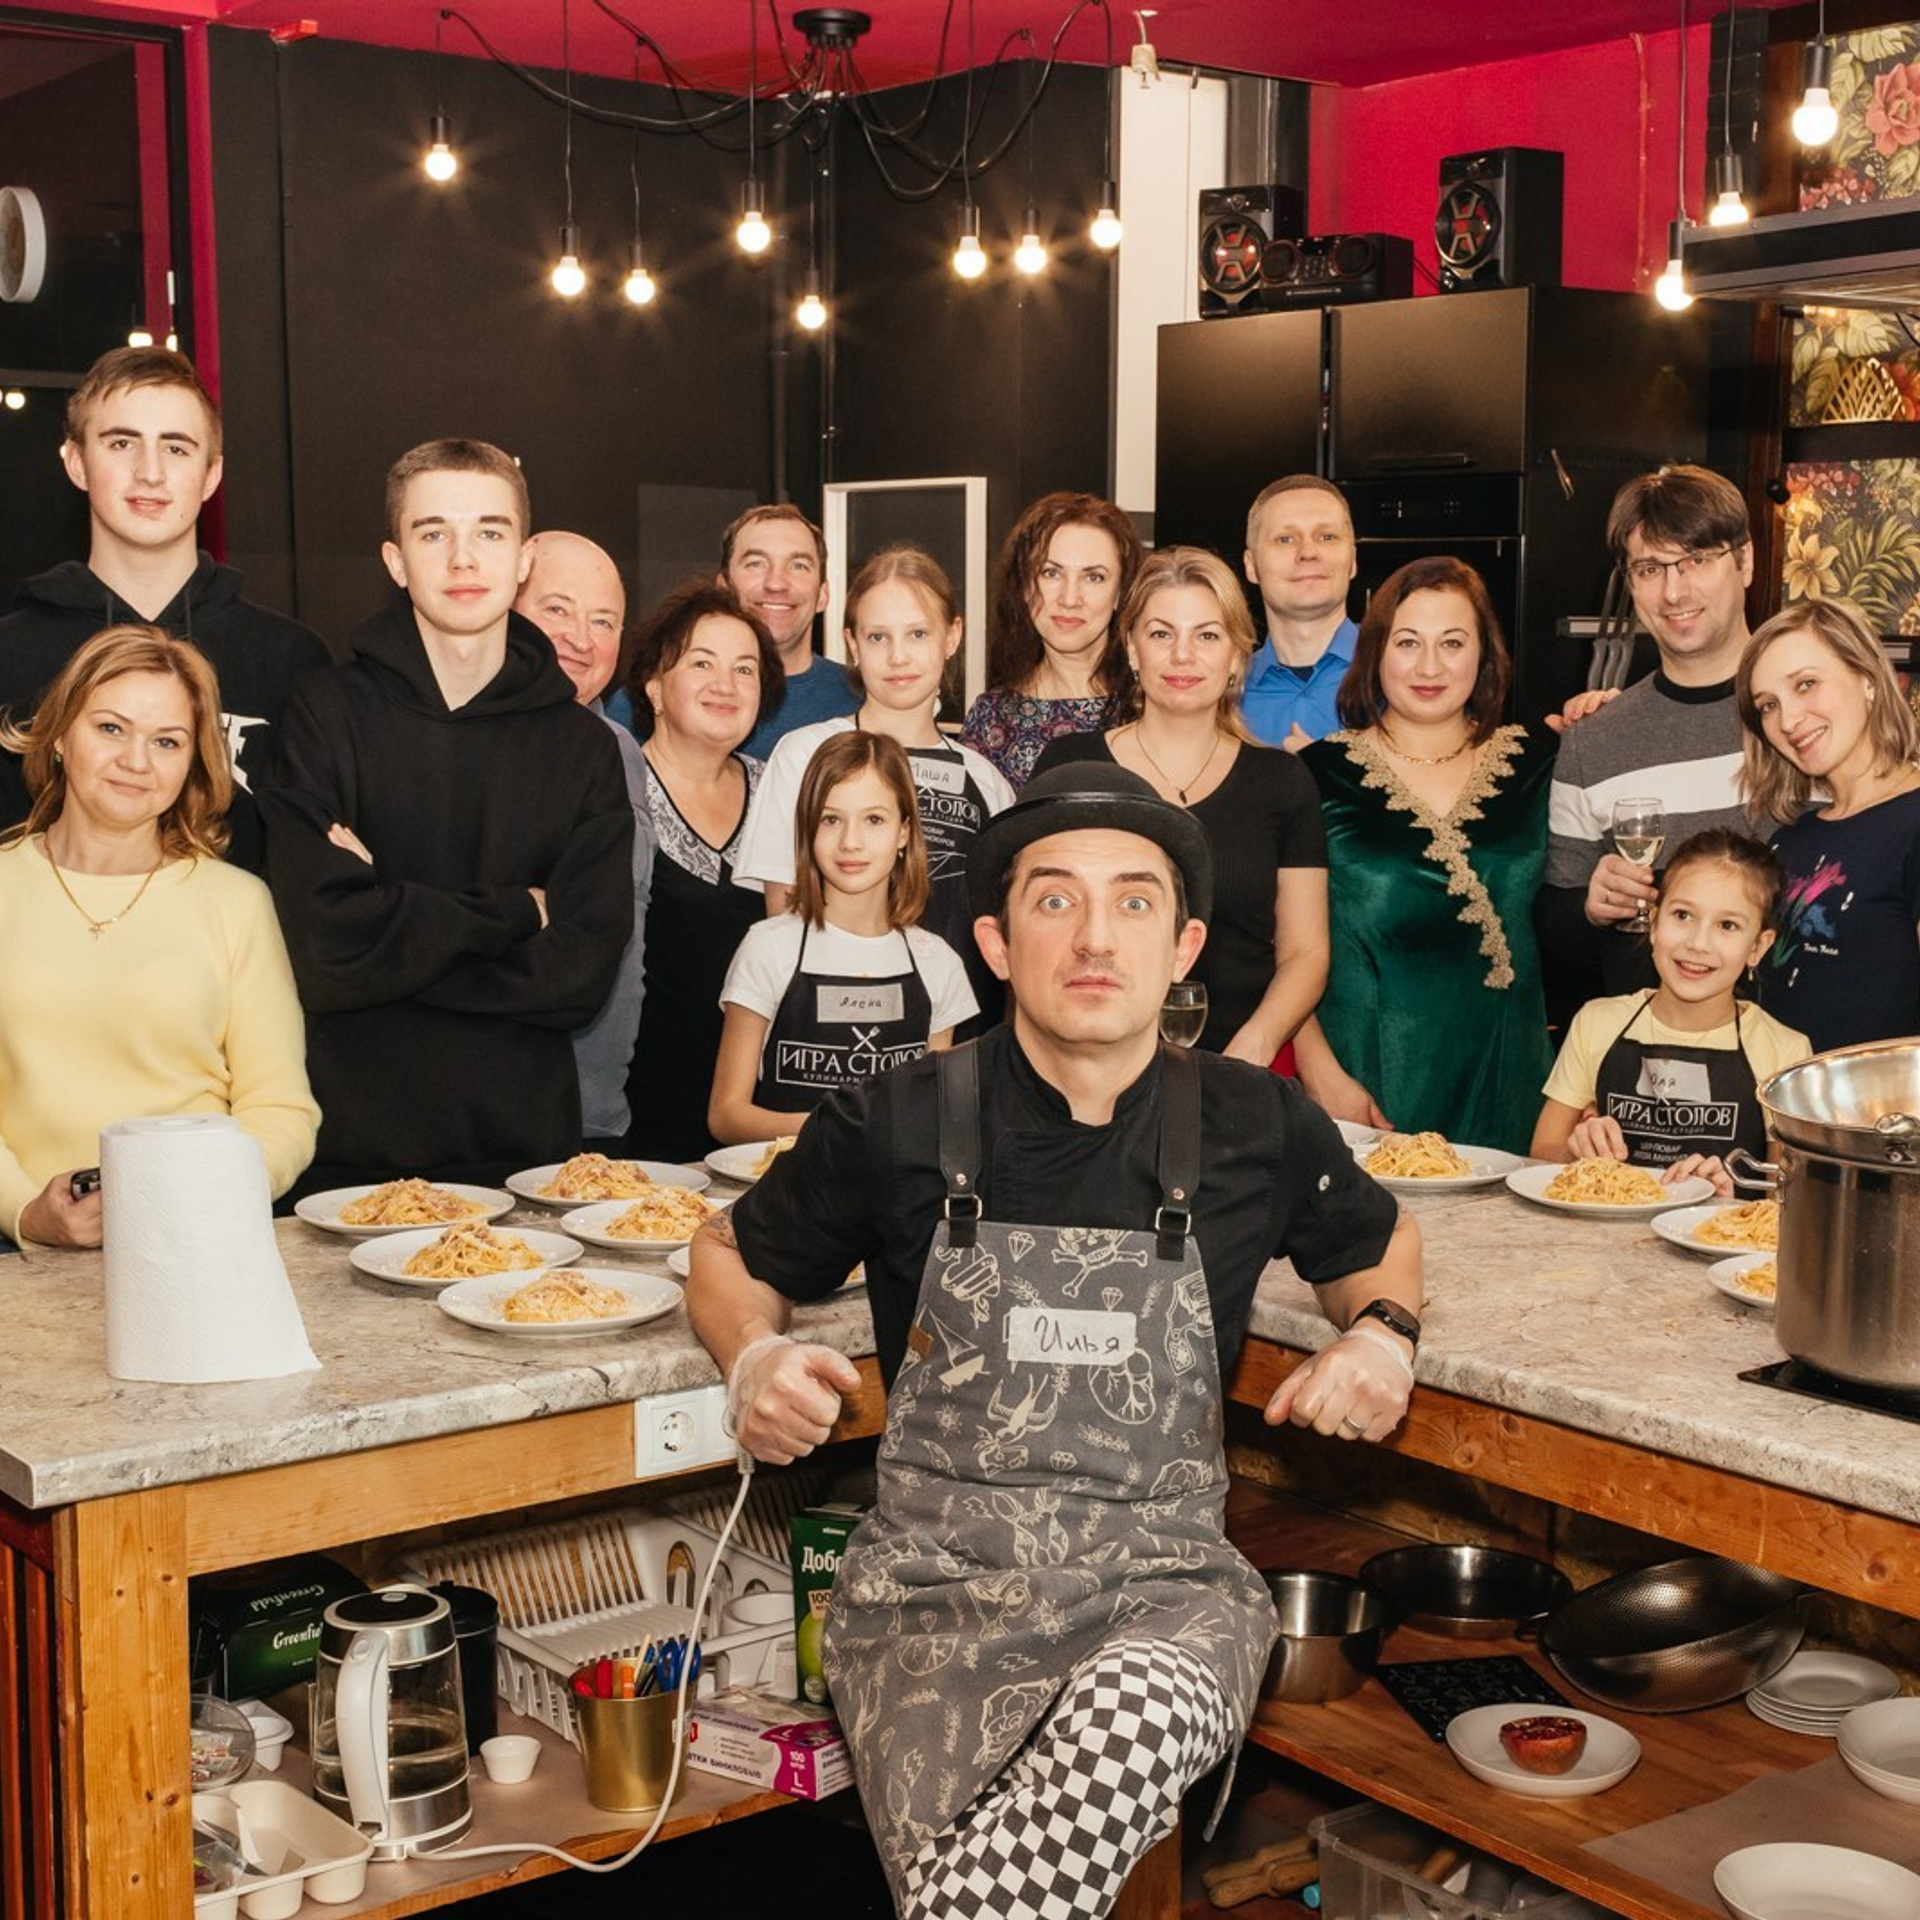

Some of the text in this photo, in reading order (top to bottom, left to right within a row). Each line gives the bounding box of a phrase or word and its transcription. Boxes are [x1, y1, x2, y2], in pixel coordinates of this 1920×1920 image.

[782, 1047, 842, 1073] ИГРА
[1611, 1098, 1731, 1126] ИГРА СТОЛОВ
